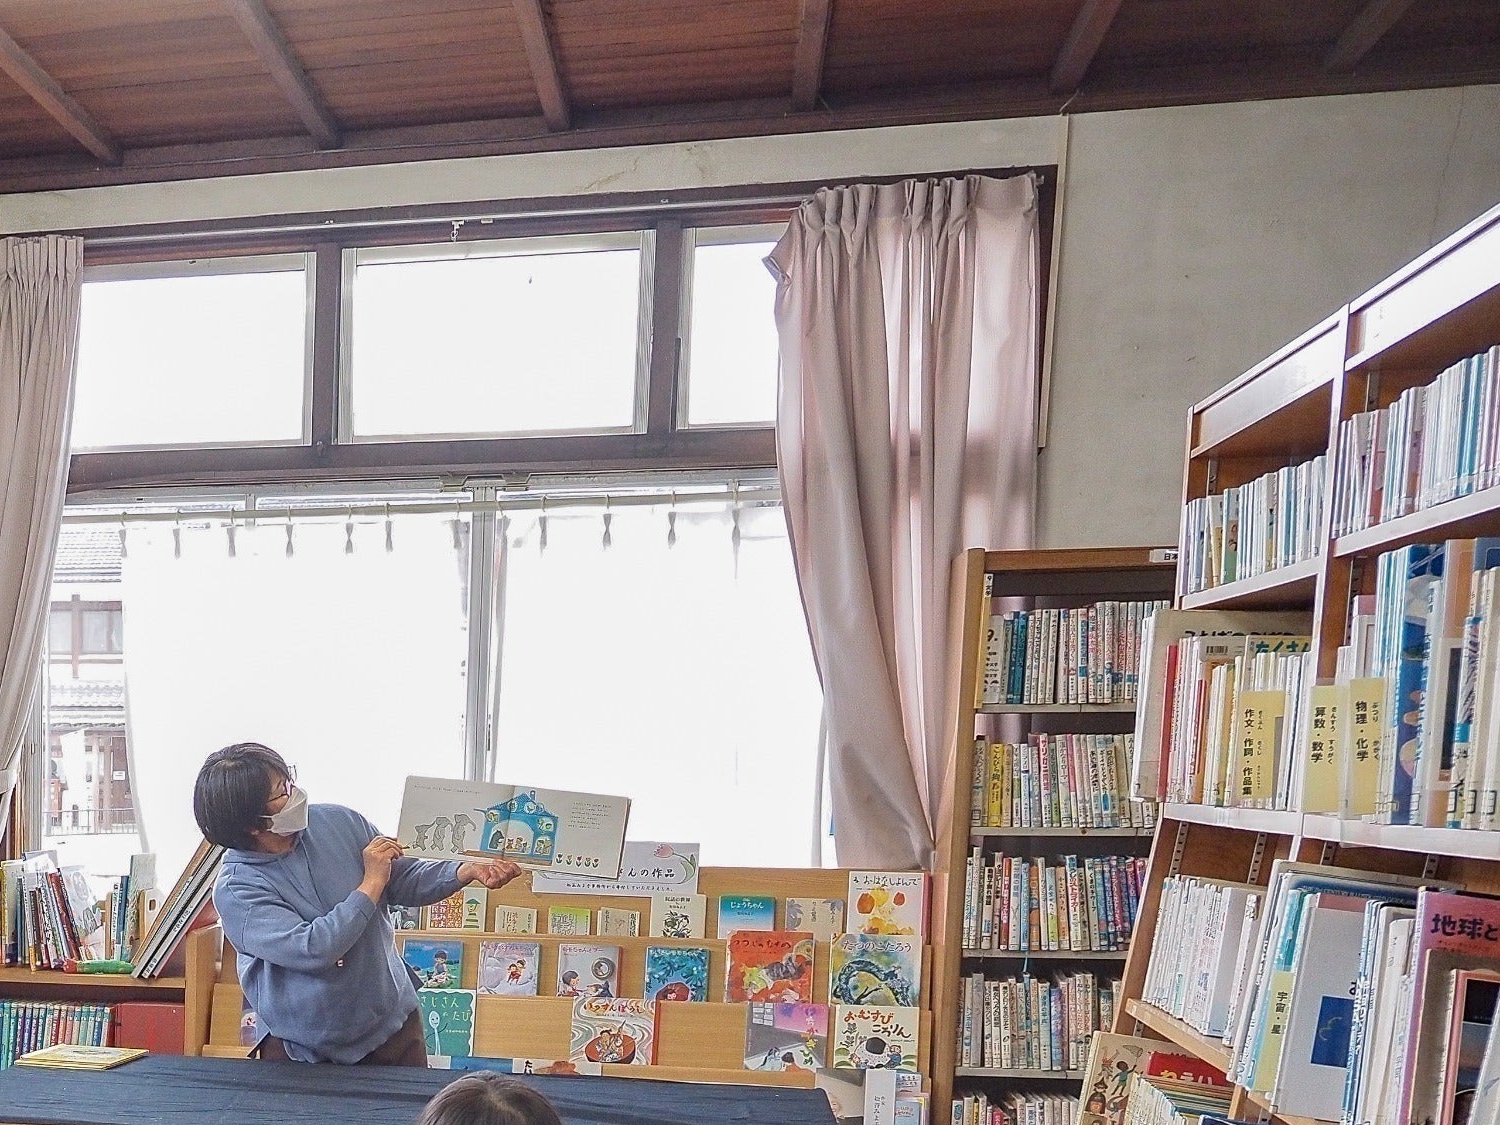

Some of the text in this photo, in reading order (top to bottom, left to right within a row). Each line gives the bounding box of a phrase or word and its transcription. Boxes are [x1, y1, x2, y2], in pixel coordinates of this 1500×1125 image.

[1311, 706, 1327, 763] 算数・数学
[1355, 701, 1369, 762] 物理・化学
[1242, 708, 1255, 795] 作文・作詞・作品集
[863, 874, 922, 887] おはなしよんで
[1430, 913, 1499, 941] 地球と
[843, 940, 912, 952] たつのこたろう
[844, 1008, 895, 1023] おむすび
[1270, 990, 1288, 1035] 宇宙・星
[872, 1023, 912, 1038] ころりん
